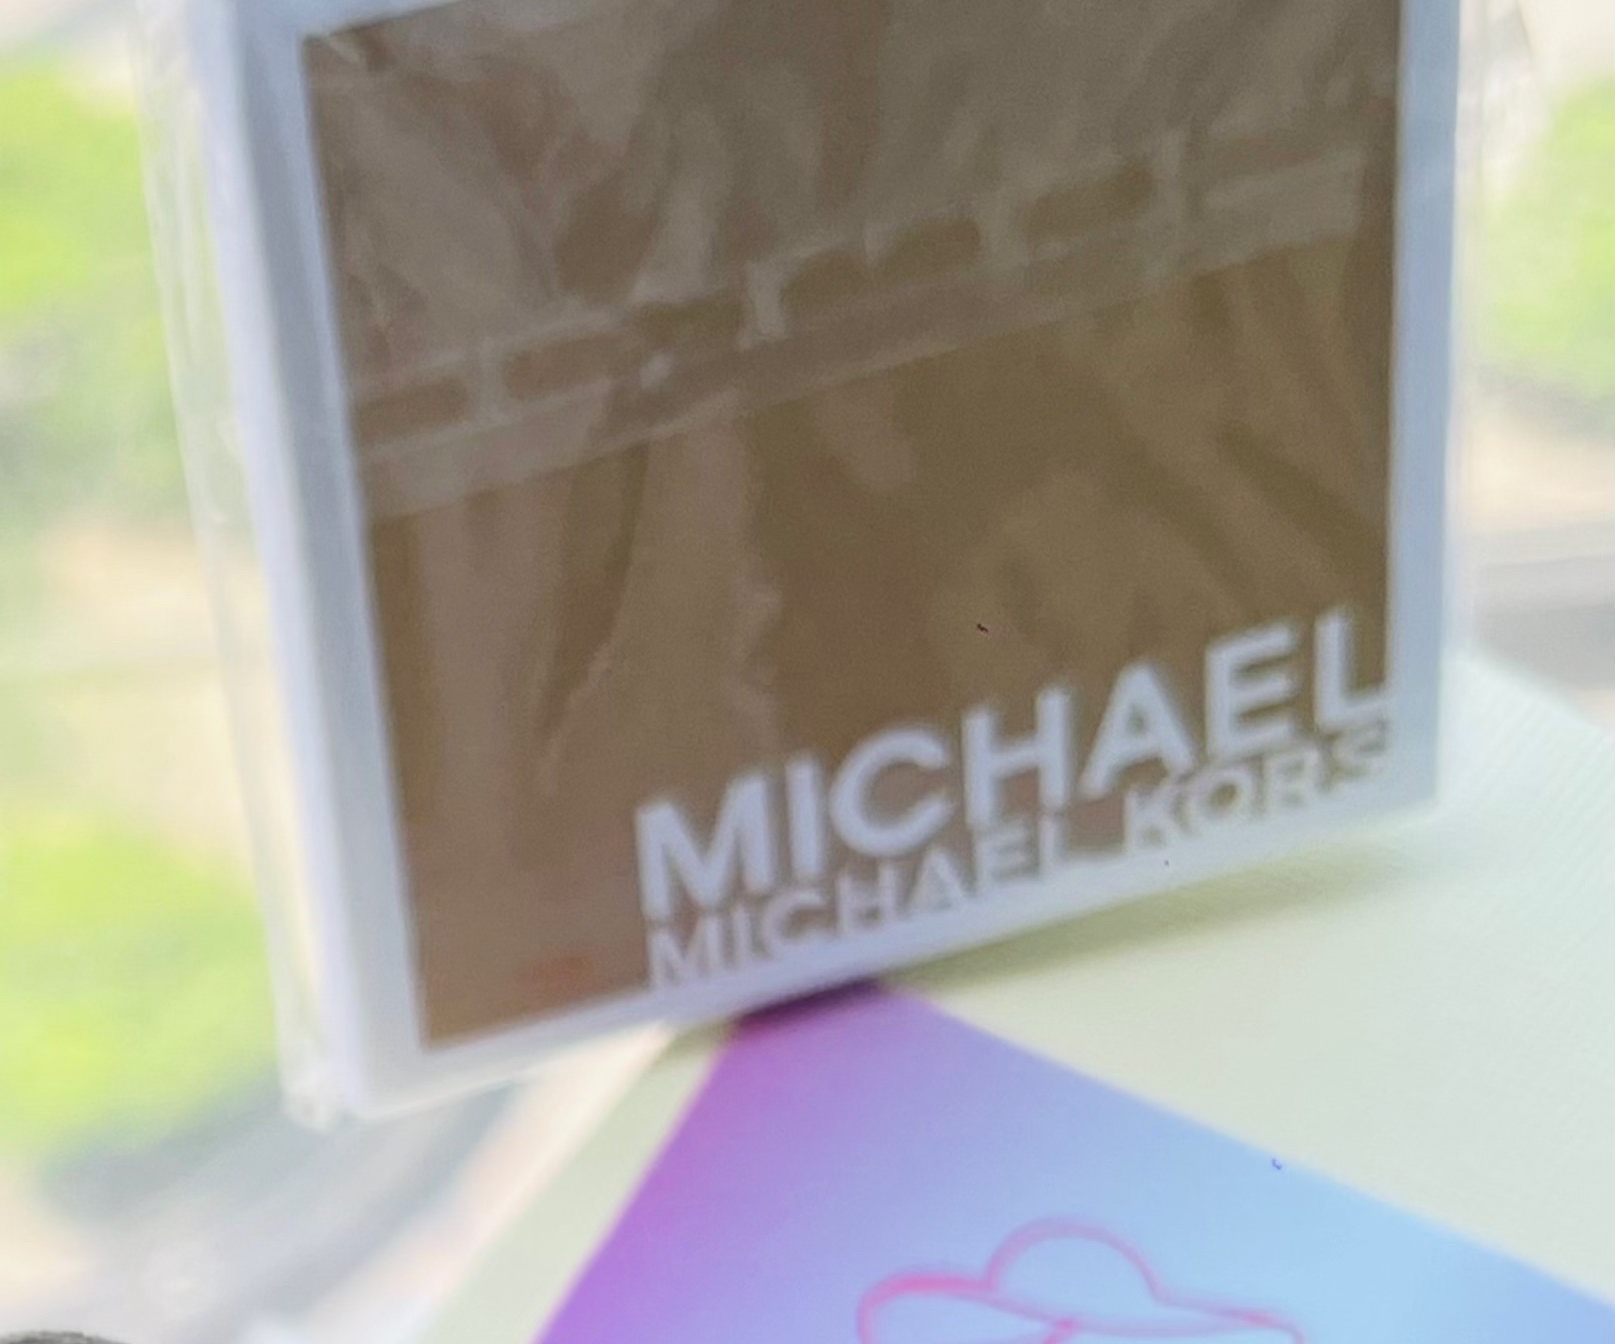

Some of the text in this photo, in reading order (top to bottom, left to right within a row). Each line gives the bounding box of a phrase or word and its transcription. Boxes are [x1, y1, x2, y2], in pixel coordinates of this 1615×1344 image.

[631, 605, 1391, 922] MICHAEL
[647, 716, 1391, 996] MICHAEL KORS
